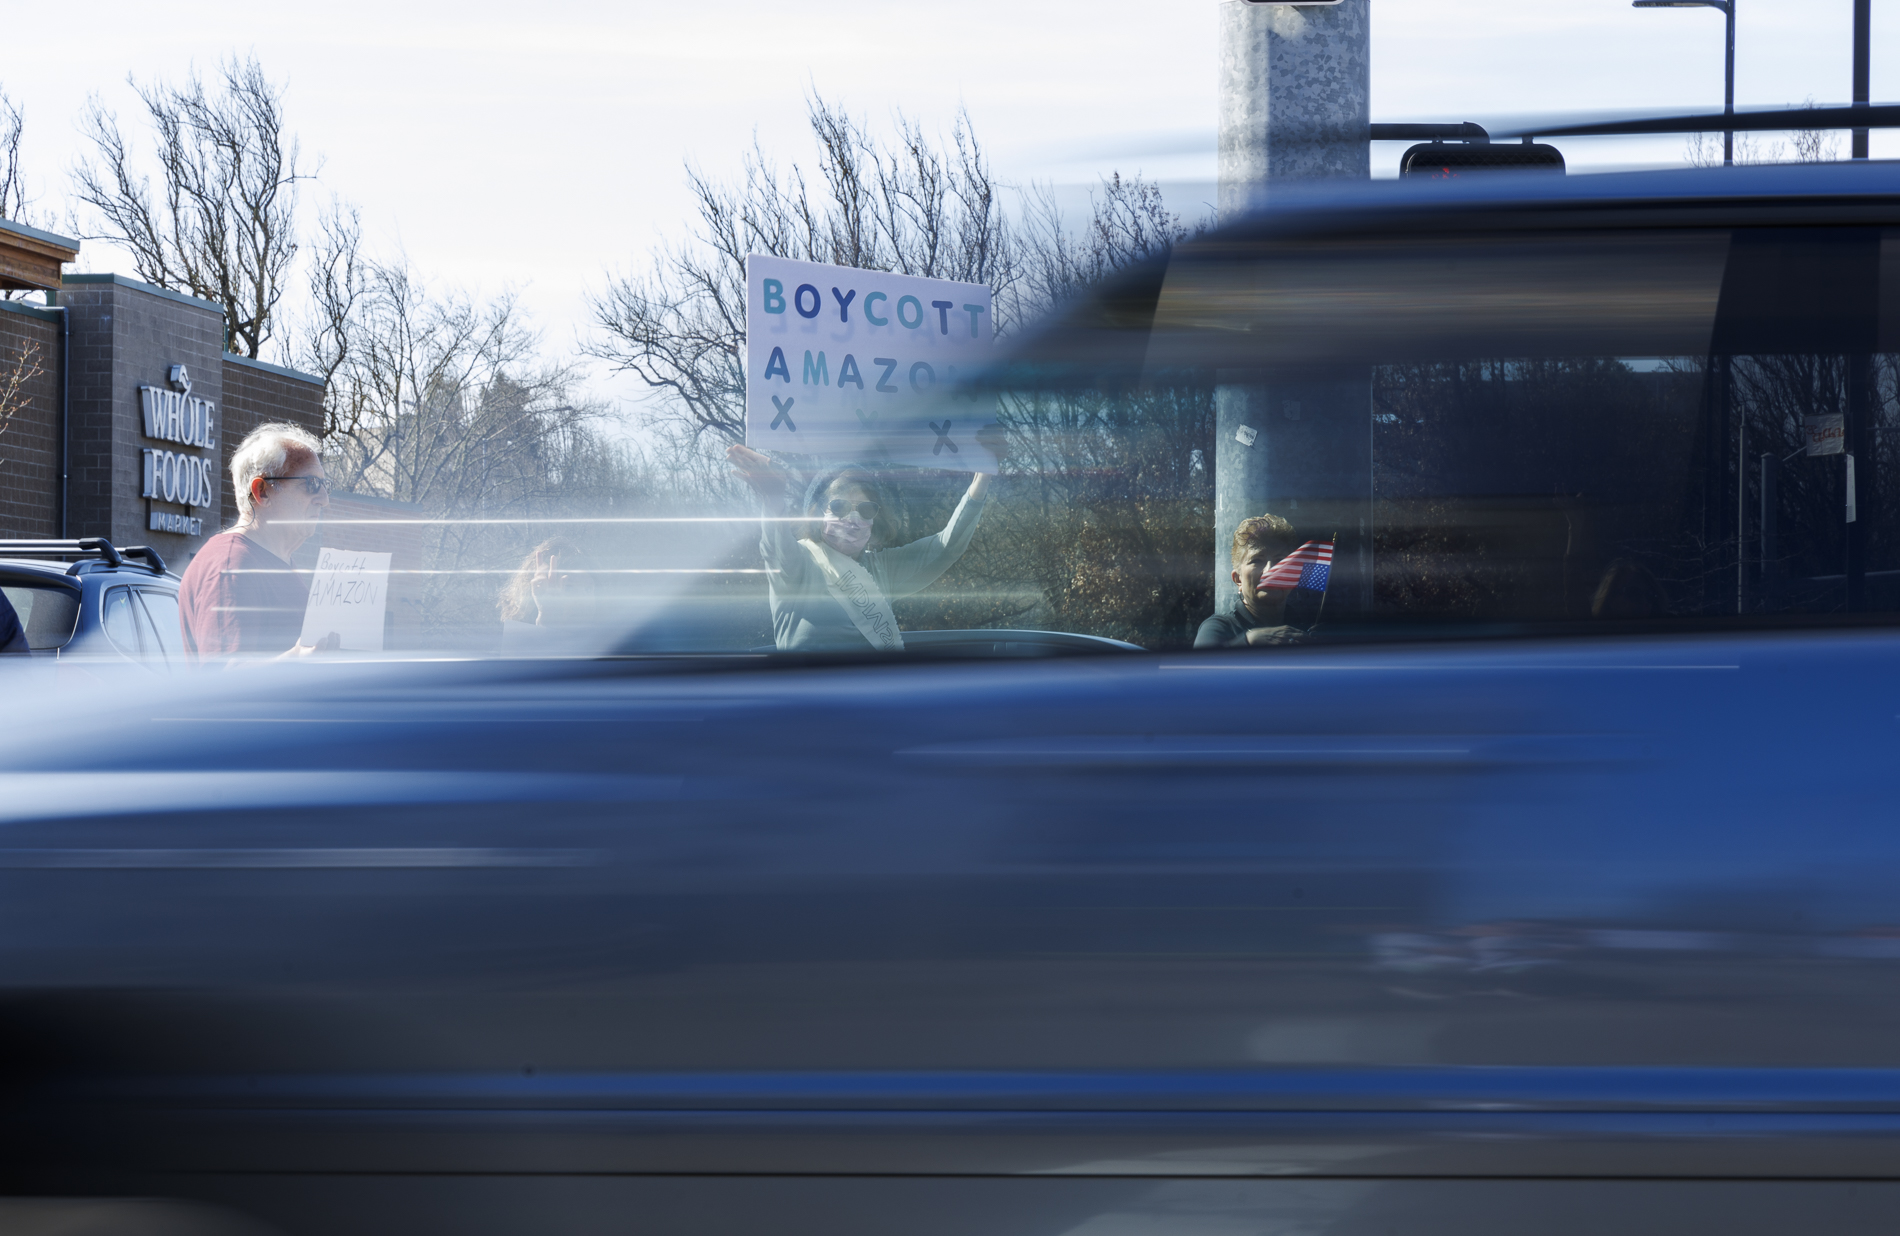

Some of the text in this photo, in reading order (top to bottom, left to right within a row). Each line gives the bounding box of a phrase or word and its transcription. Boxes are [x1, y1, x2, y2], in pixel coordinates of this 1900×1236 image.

[762, 277, 985, 339] BOYCOTT
[144, 386, 215, 450] WHOLE
[769, 394, 797, 433] X
[928, 419, 959, 456] X
[146, 449, 212, 508] FOODS
[156, 512, 203, 535] MARKET
[308, 580, 378, 606] AMAZON
[320, 552, 367, 580] Boycott
